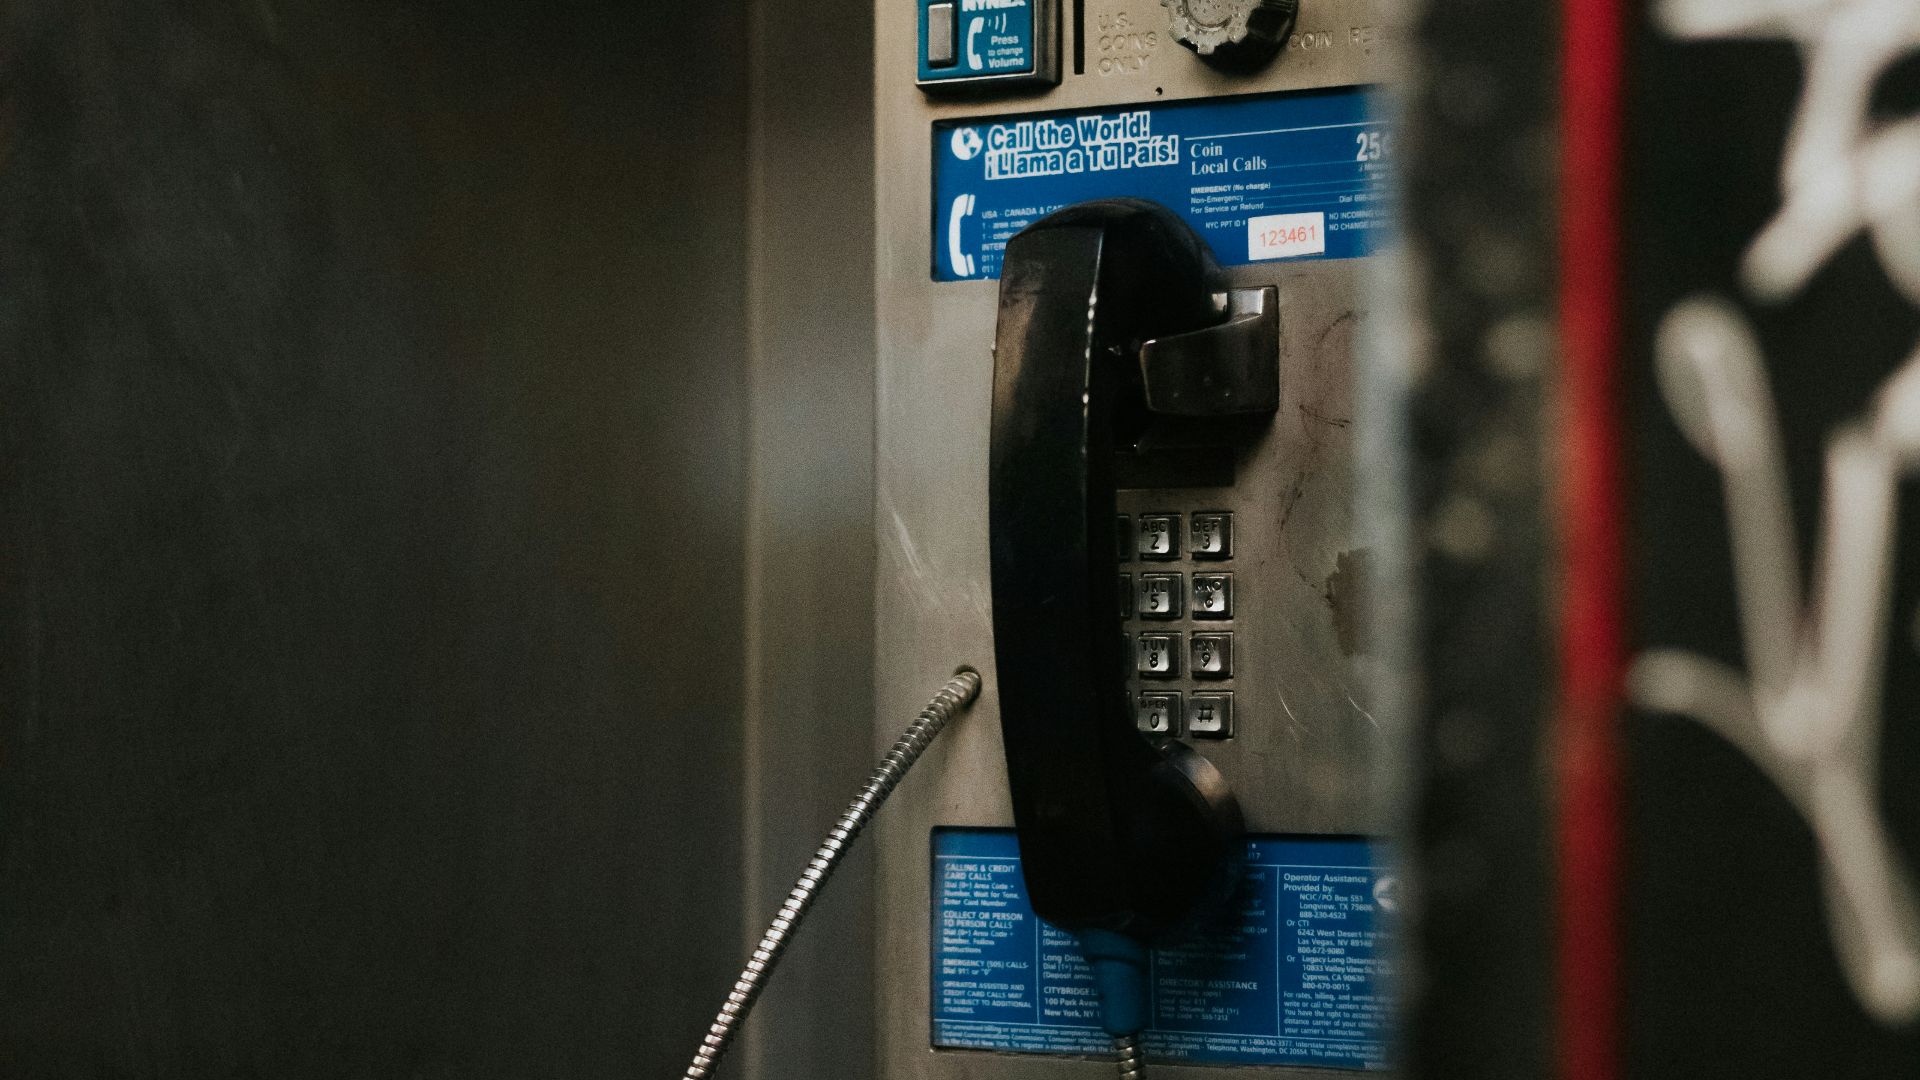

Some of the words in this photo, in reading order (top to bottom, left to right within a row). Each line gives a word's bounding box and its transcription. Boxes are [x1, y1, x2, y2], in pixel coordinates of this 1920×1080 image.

[1099, 12, 1133, 31] U.S.
[991, 35, 1019, 45] Press
[1099, 31, 1158, 52] COINS
[1289, 31, 1334, 49] COIN
[996, 47, 1023, 57] change
[988, 58, 1024, 68] Volume
[1099, 54, 1150, 75] ONLY
[987, 121, 1034, 153] Call
[1034, 119, 1075, 149] the
[1076, 110, 1151, 146] World!
[1190, 142, 1223, 158] Coin
[985, 150, 1064, 181] ¡Llama
[1066, 149, 1084, 173] a
[1086, 144, 1120, 171] Tu
[1119, 135, 1180, 169] País!
[1191, 158, 1228, 175] Local
[1233, 155, 1268, 172] Calls
[1190, 184, 1231, 194] EMERGENCY
[1232, 184, 1245, 193] (No
[1246, 182, 1271, 192] charge)
[1190, 195, 1243, 204] Non-Emergency
[982, 210, 998, 219] USA
[1004, 207, 1037, 217] CANADA
[1204, 205, 1229, 213] Service
[1240, 202, 1264, 210] Refund
[1205, 221, 1219, 229] NYC
[1220, 220, 1233, 228] PPT
[1329, 223, 1339, 231] NO
[1260, 225, 1316, 248] 123461
[1141, 520, 1166, 532] ABC
[1193, 520, 1218, 532] DEF
[1150, 534, 1160, 550] 2
[1202, 533, 1210, 549] 3
[1143, 581, 1167, 592] JKL
[1150, 593, 1160, 610] 5
[1204, 593, 1213, 609] 6
[1141, 639, 1166, 651] TUV
[1150, 651, 1159, 669] 8
[1201, 651, 1211, 668] 9
[1197, 704, 1214, 723] #
[1150, 713, 1159, 729] 0
[944, 863, 978, 872] CALLING
[988, 864, 1016, 873] CREDIT
[968, 873, 992, 881] CALLS
[1283, 873, 1321, 883] Operator
[1323, 874, 1368, 884] Assistance
[1283, 884, 1320, 892] Provided
[1322, 884, 1334, 894] by:
[1334, 895, 1348, 903] Box
[1339, 903, 1348, 911] TX
[944, 910, 976, 919] COLLECT
[978, 911, 990, 919] OR
[992, 911, 1023, 921] PERSON
[944, 918, 955, 927] TO
[956, 919, 987, 928] PERSON
[988, 921, 1013, 929] CALLS
[1286, 919, 1296, 927] Or
[1298, 919, 1310, 927] CTI
[1297, 929, 1315, 937] 6242
[1316, 929, 1335, 938] West
[1337, 930, 1362, 938] Desert
[1337, 938, 1348, 946] NV
[943, 958, 985, 967] EMERGENCY
[1043, 953, 1063, 964] Long
[1286, 955, 1296, 963] Or
[1302, 955, 1326, 964] Legacy
[1327, 956, 1345, 965] Long
[1043, 962, 1056, 970] Dial
[1324, 965, 1345, 974] Valley
[1010, 983, 1025, 991] AND
[1207, 979, 1258, 990] ASSISTANCE
[1302, 982, 1351, 990] 800-670-0015
[967, 990, 985, 998] CARD
[986, 990, 1006, 999] CALLS
[1043, 986, 1090, 996] CITYBRIDGE
[1296, 992, 1312, 1000] rates,
[1338, 993, 1350, 1001] and
[992, 1000, 1032, 1008] ADDITIONAL
[1044, 997, 1059, 1006] 100
[1060, 998, 1077, 1006] Park
[1044, 1009, 1061, 1017] New
[1063, 1009, 1082, 1018] York,
[1083, 1010, 1094, 1018] NY
[1297, 1009, 1312, 1017] have
[1326, 1010, 1341, 1019] right
[1284, 1027, 1299, 1035] your
[1204, 1037, 1239, 1045] Commission
[1295, 1040, 1325, 1048] Interstate
[1206, 1043, 1239, 1052] Telephone,
[1240, 1046, 1278, 1056] Washington,
[1310, 1049, 1324, 1057] This
[1324, 1050, 1344, 1059] phone
